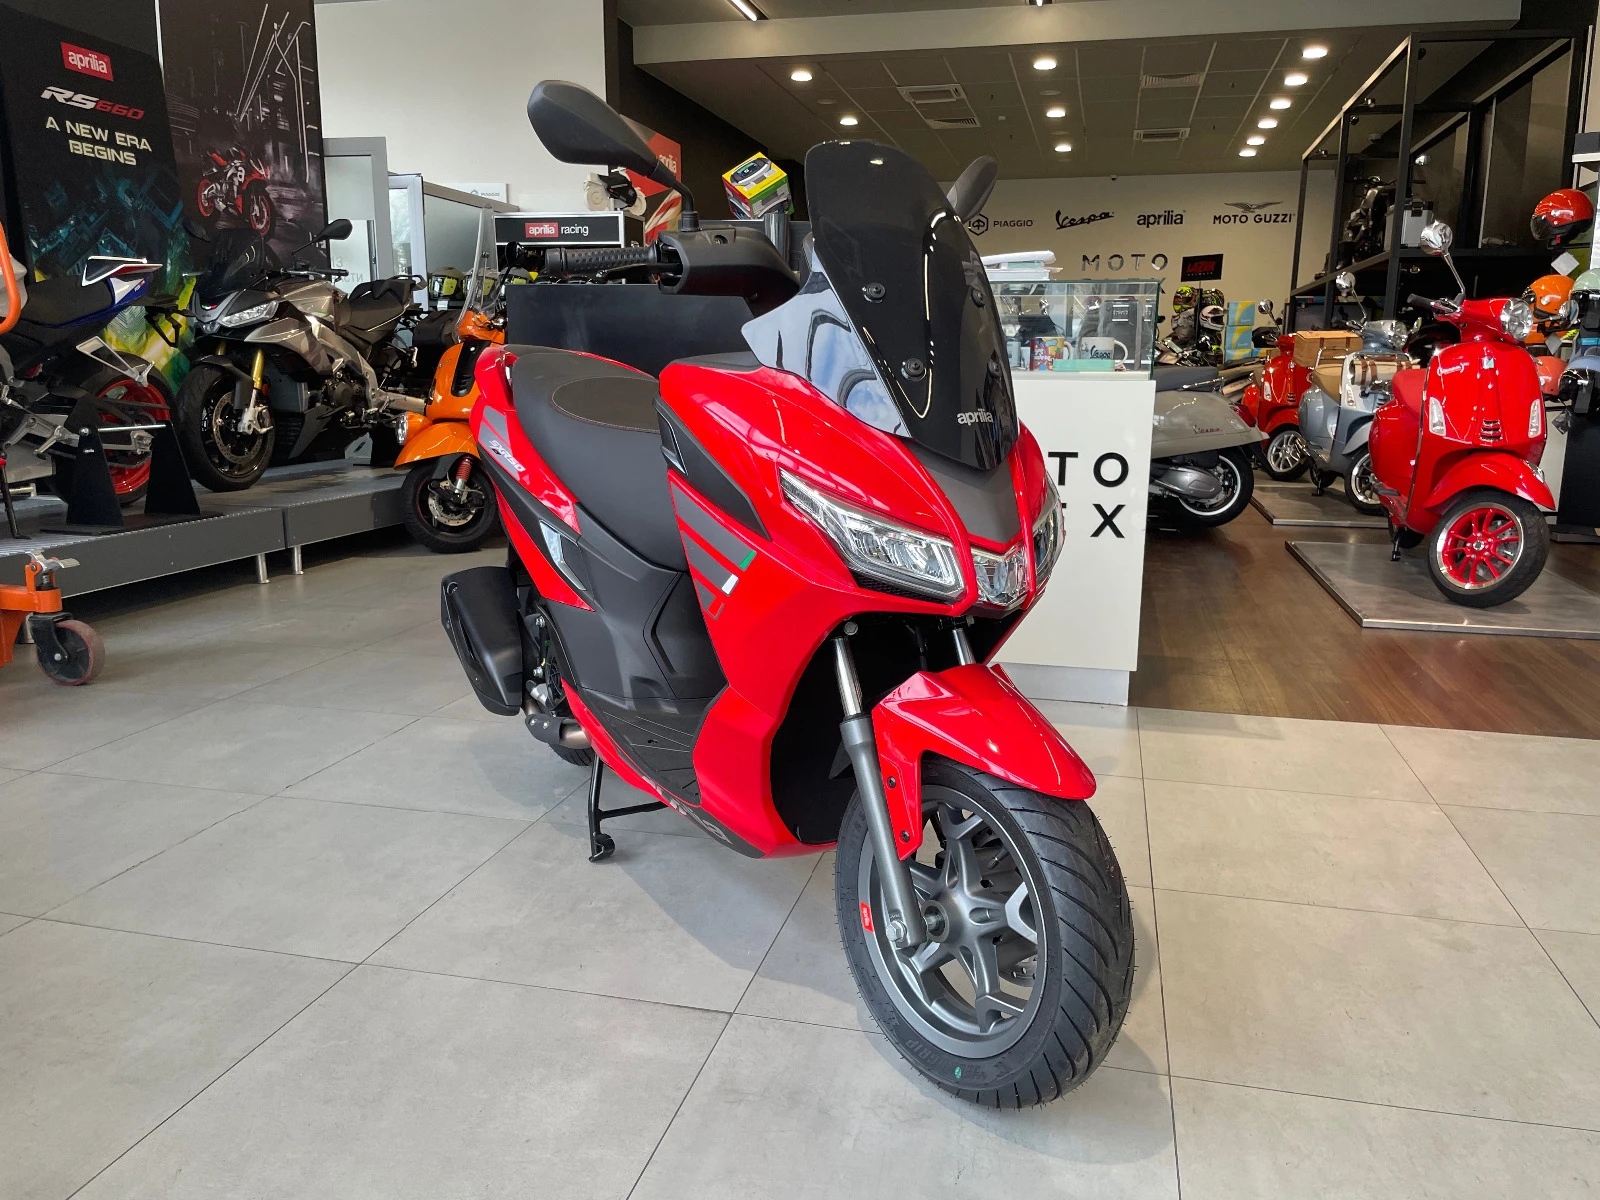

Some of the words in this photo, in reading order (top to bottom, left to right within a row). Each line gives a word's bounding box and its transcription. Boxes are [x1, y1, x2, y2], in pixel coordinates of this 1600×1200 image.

[68, 51, 108, 74] aprilia
[46, 116, 60, 131] A
[65, 120, 109, 142] NEW
[115, 131, 152, 152] ERA
[69, 139, 137, 166] BEGINS
[993, 219, 1033, 228] PIAGGIO
[1055, 209, 1115, 230] Vespa
[1137, 210, 1184, 228] aprilia
[1213, 214, 1249, 225] MOTO
[1253, 213, 1292, 224] GUZZI
[529, 224, 555, 237] aprilia
[561, 223, 589, 237] racing
[1081, 253, 1168, 271] MOTO
[957, 408, 994, 426] aprilia
[1047, 451, 1129, 488] TO
